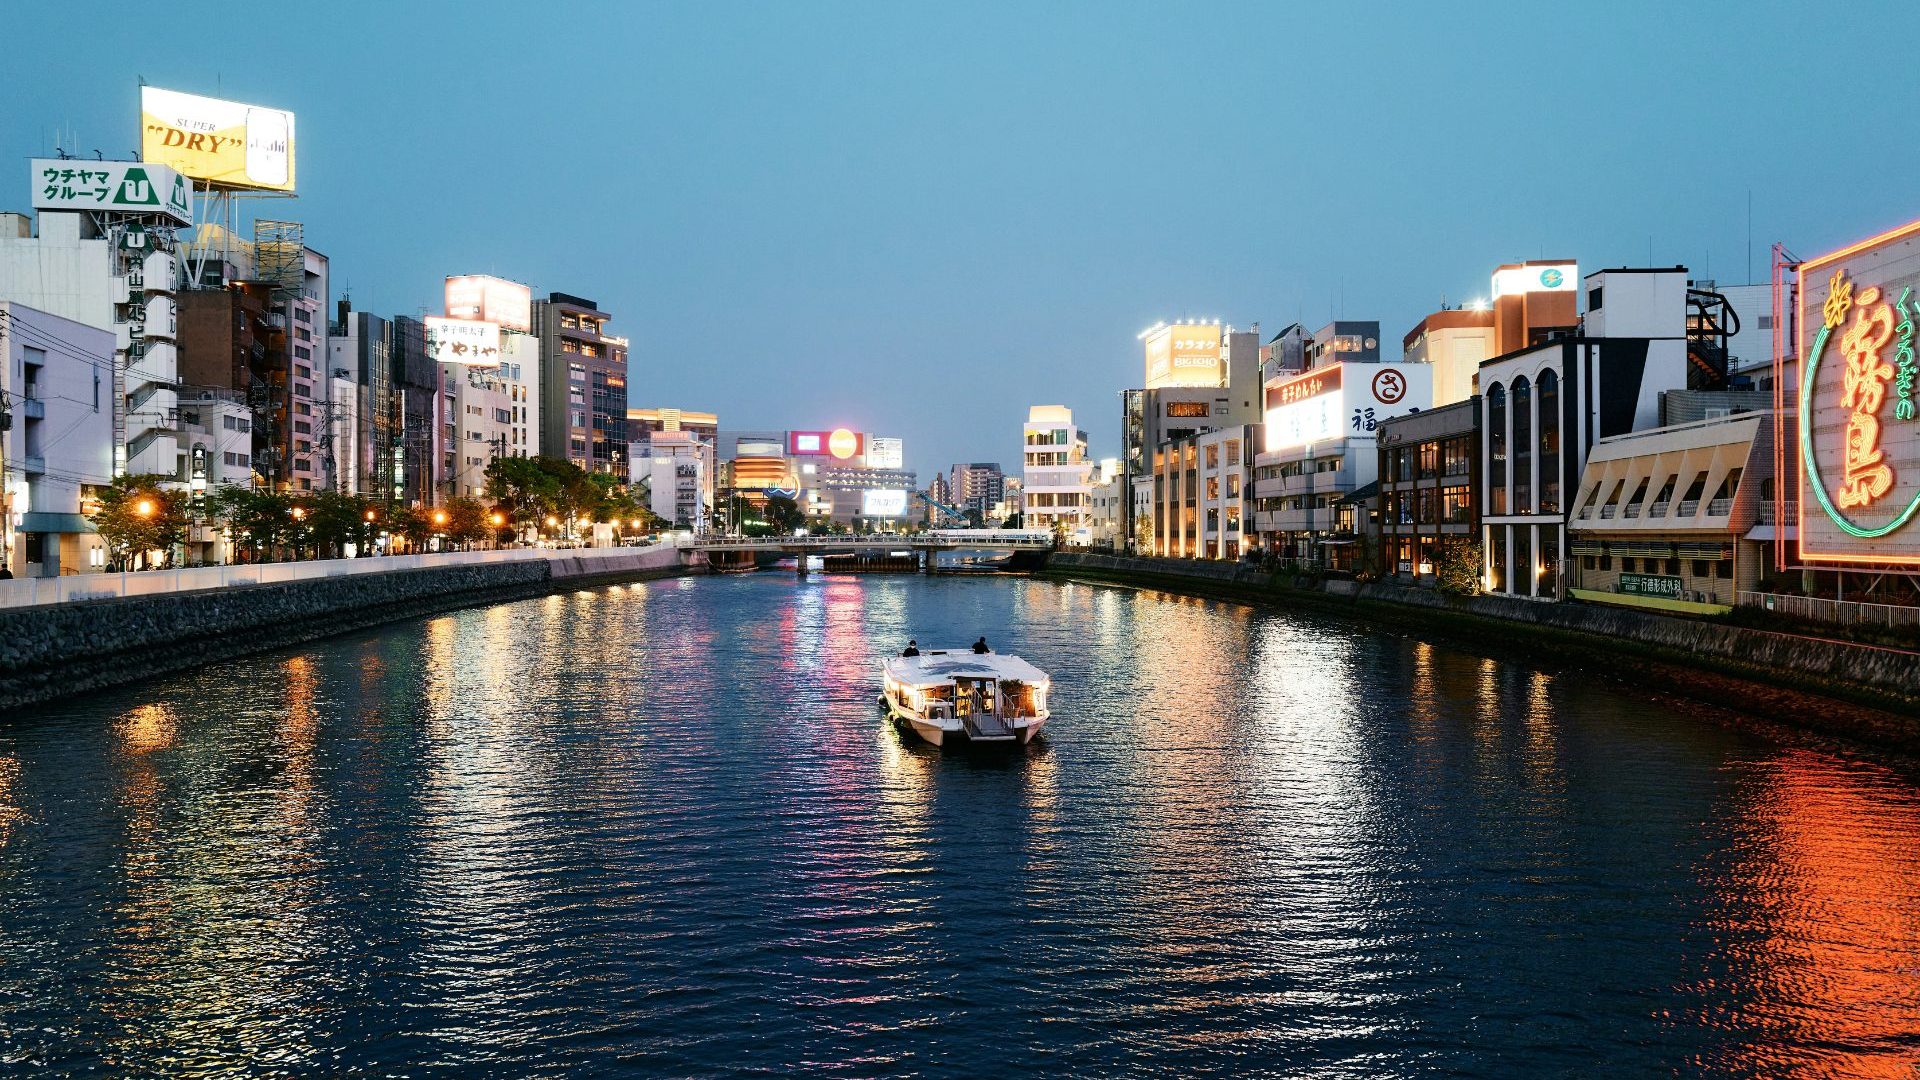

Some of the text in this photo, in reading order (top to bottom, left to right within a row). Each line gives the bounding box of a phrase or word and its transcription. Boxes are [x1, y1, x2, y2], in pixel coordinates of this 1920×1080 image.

[176, 118, 216, 132] SUPER
[43, 168, 110, 185] ウチヤマ
[43, 185, 111, 202] グループ
[1174, 340, 1217, 350] カラオケ
[1894, 285, 1919, 421] くつろぎの
